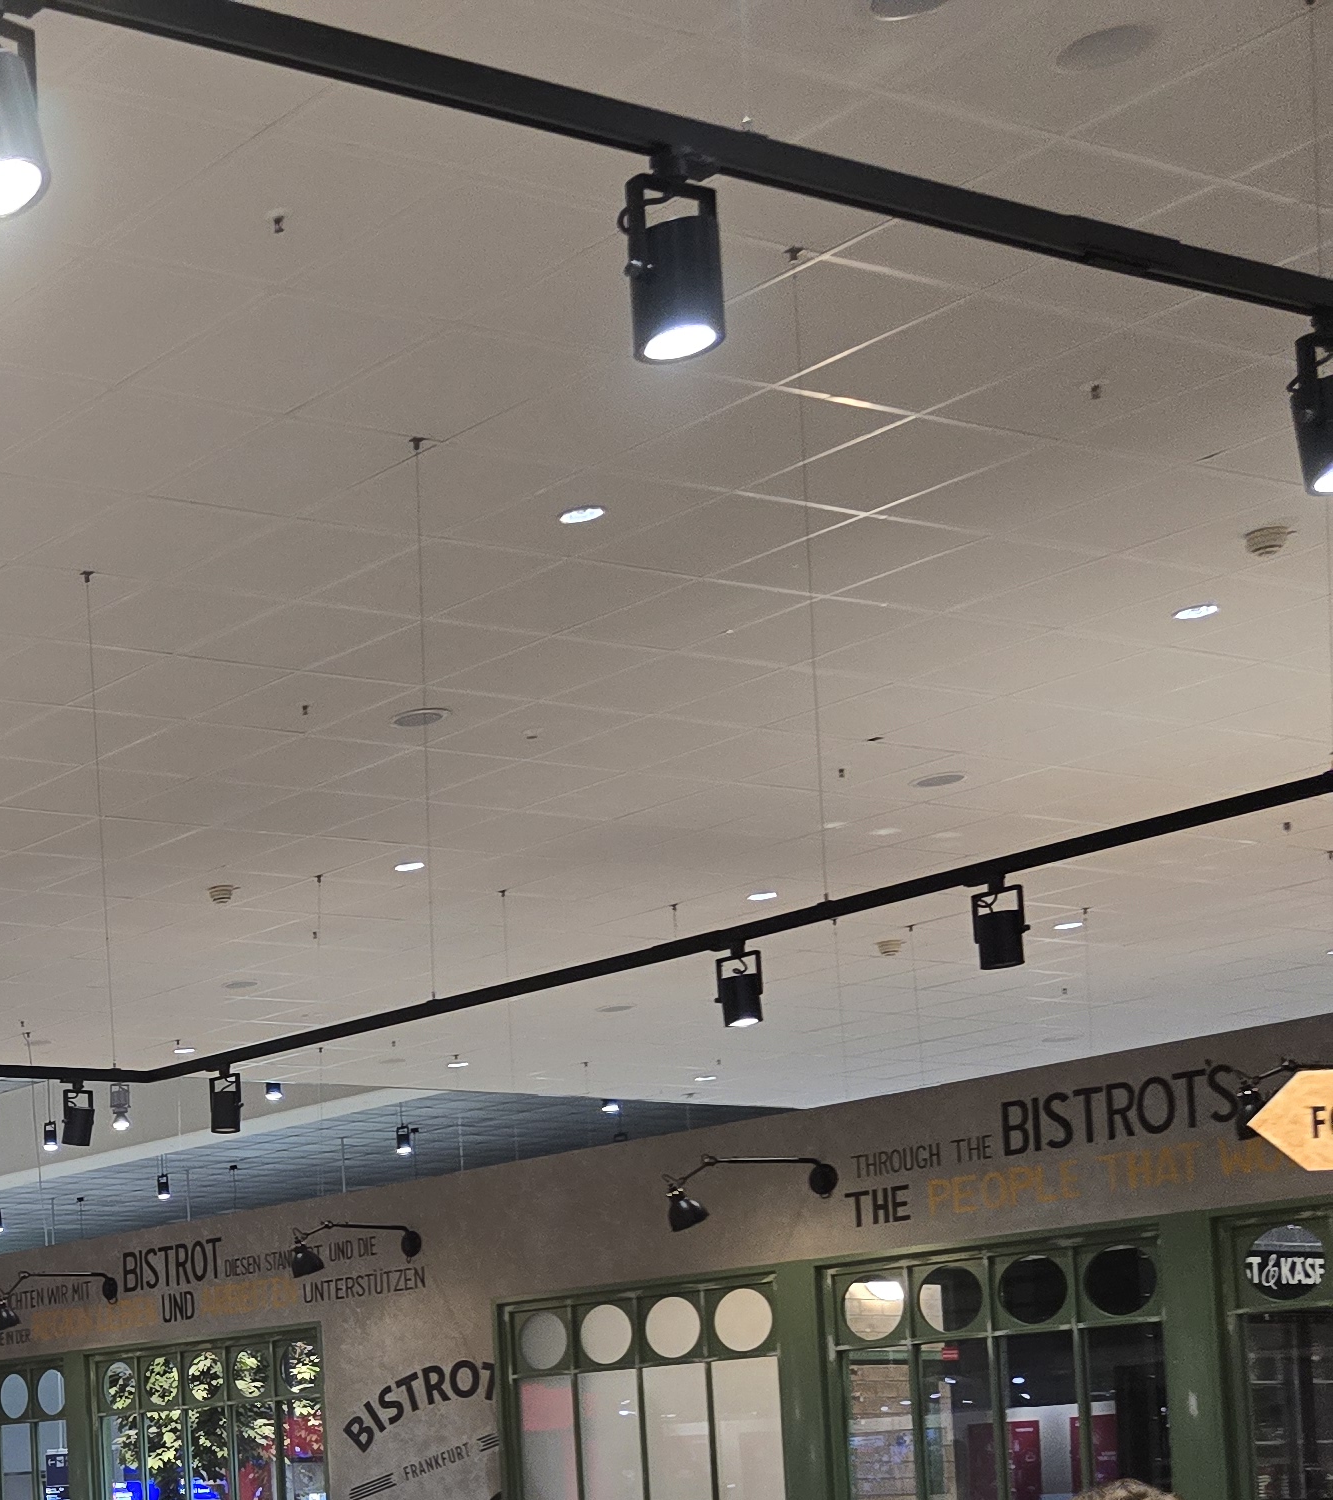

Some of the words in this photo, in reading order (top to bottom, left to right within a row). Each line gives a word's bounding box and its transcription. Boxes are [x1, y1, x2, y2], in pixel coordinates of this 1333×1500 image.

[844, 1184, 912, 1228] THE
[927, 1156, 1082, 1216] PEOPLE
[1096, 1140, 1201, 1193] THAT
[851, 1142, 942, 1179] THROUGH
[951, 1134, 993, 1163] THE
[47, 1285, 68, 1305] WIR
[72, 1280, 92, 1301] MIT
[122, 1236, 222, 1293] BISTROT
[224, 1253, 261, 1278] DIESEN
[329, 1240, 353, 1263] UND
[357, 1235, 378, 1258] DIE
[161, 1290, 195, 1323] UND
[302, 1265, 427, 1304] UNTERSTÜTZEN
[1262, 1253, 1278, 1290] &
[342, 1359, 495, 1454] BISTROT
[402, 1441, 471, 1482] FRANKFURT
